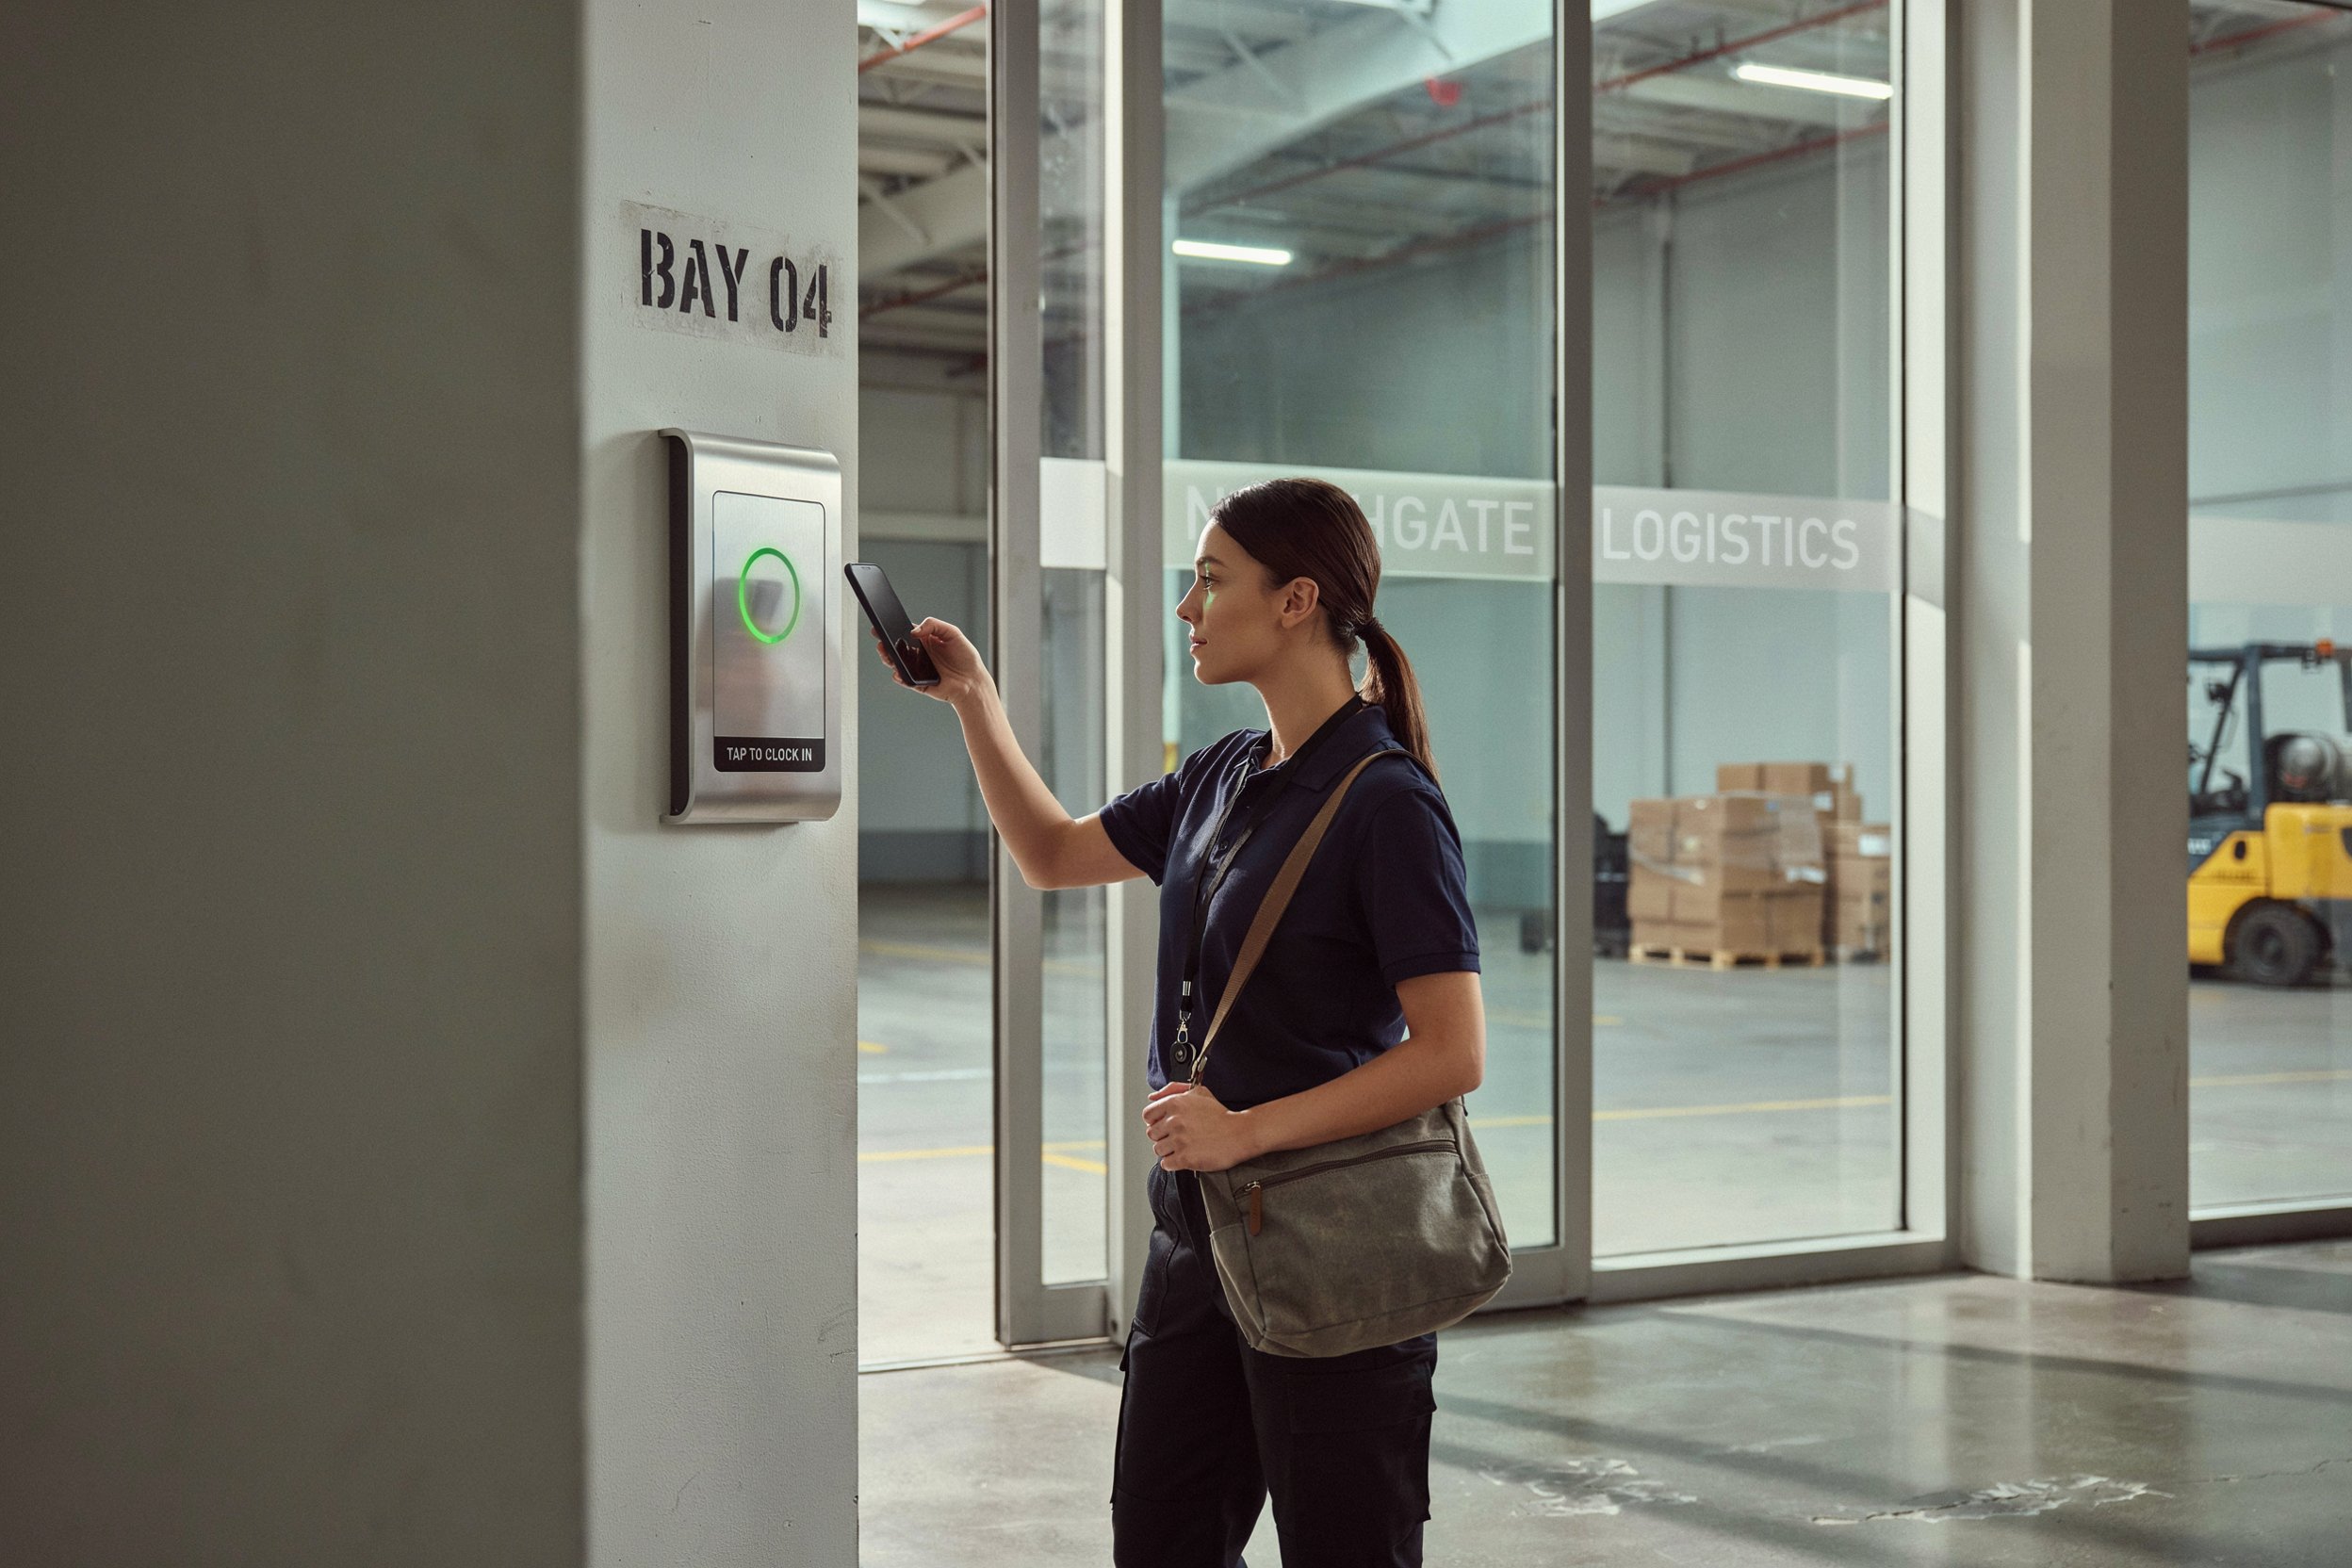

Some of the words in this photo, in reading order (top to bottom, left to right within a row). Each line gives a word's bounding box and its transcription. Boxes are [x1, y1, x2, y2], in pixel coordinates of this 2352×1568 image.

[641, 228, 750, 322] BAY
[769, 255, 833, 338] 04
[1187, 484, 1534, 555] NHGATE
[1602, 507, 1860, 570] LOGISTICS
[727, 746, 747, 760] TAP
[749, 747, 762, 760] TO
[765, 747, 799, 761] CLOCK
[801, 748, 812, 761] IN
